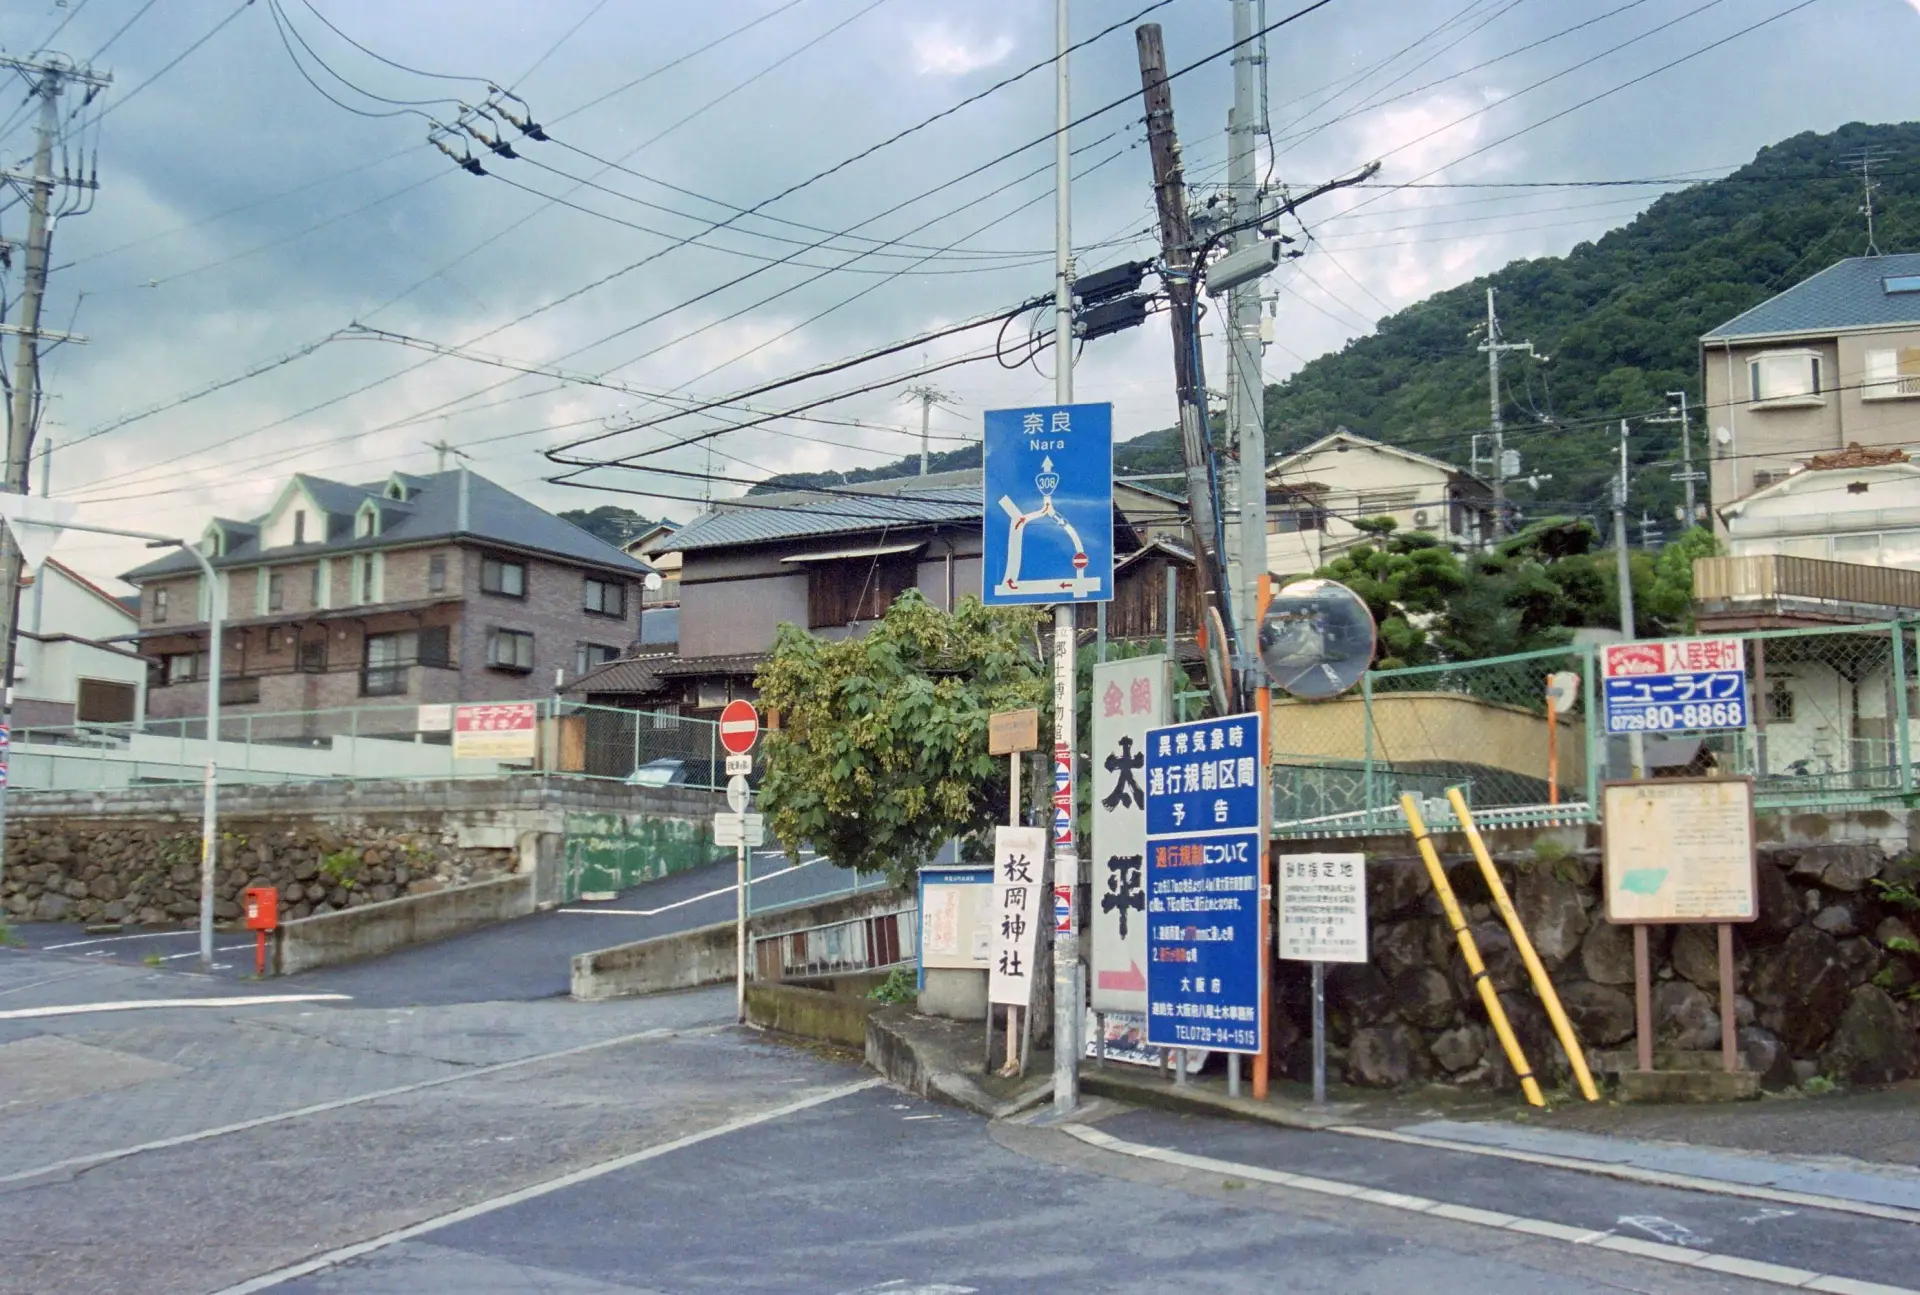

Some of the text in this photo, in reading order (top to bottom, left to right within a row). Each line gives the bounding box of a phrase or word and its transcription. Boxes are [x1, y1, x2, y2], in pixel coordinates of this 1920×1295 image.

[1023, 411, 1072, 434] 奈良
[1030, 438, 1064, 451] Nara
[1039, 478, 1056, 490] 308
[1671, 640, 1737, 671] 入居受付
[1610, 674, 1739, 701] ニューライフ
[1159, 725, 1244, 757] 異常気象時
[1150, 757, 1255, 796] 通行規制区間
[1172, 799, 1229, 826] 予告
[1156, 842, 1249, 868] 通行規制について
[999, 853, 1034, 977] 枚岡神社
[1181, 977, 1222, 994] 大阪府
